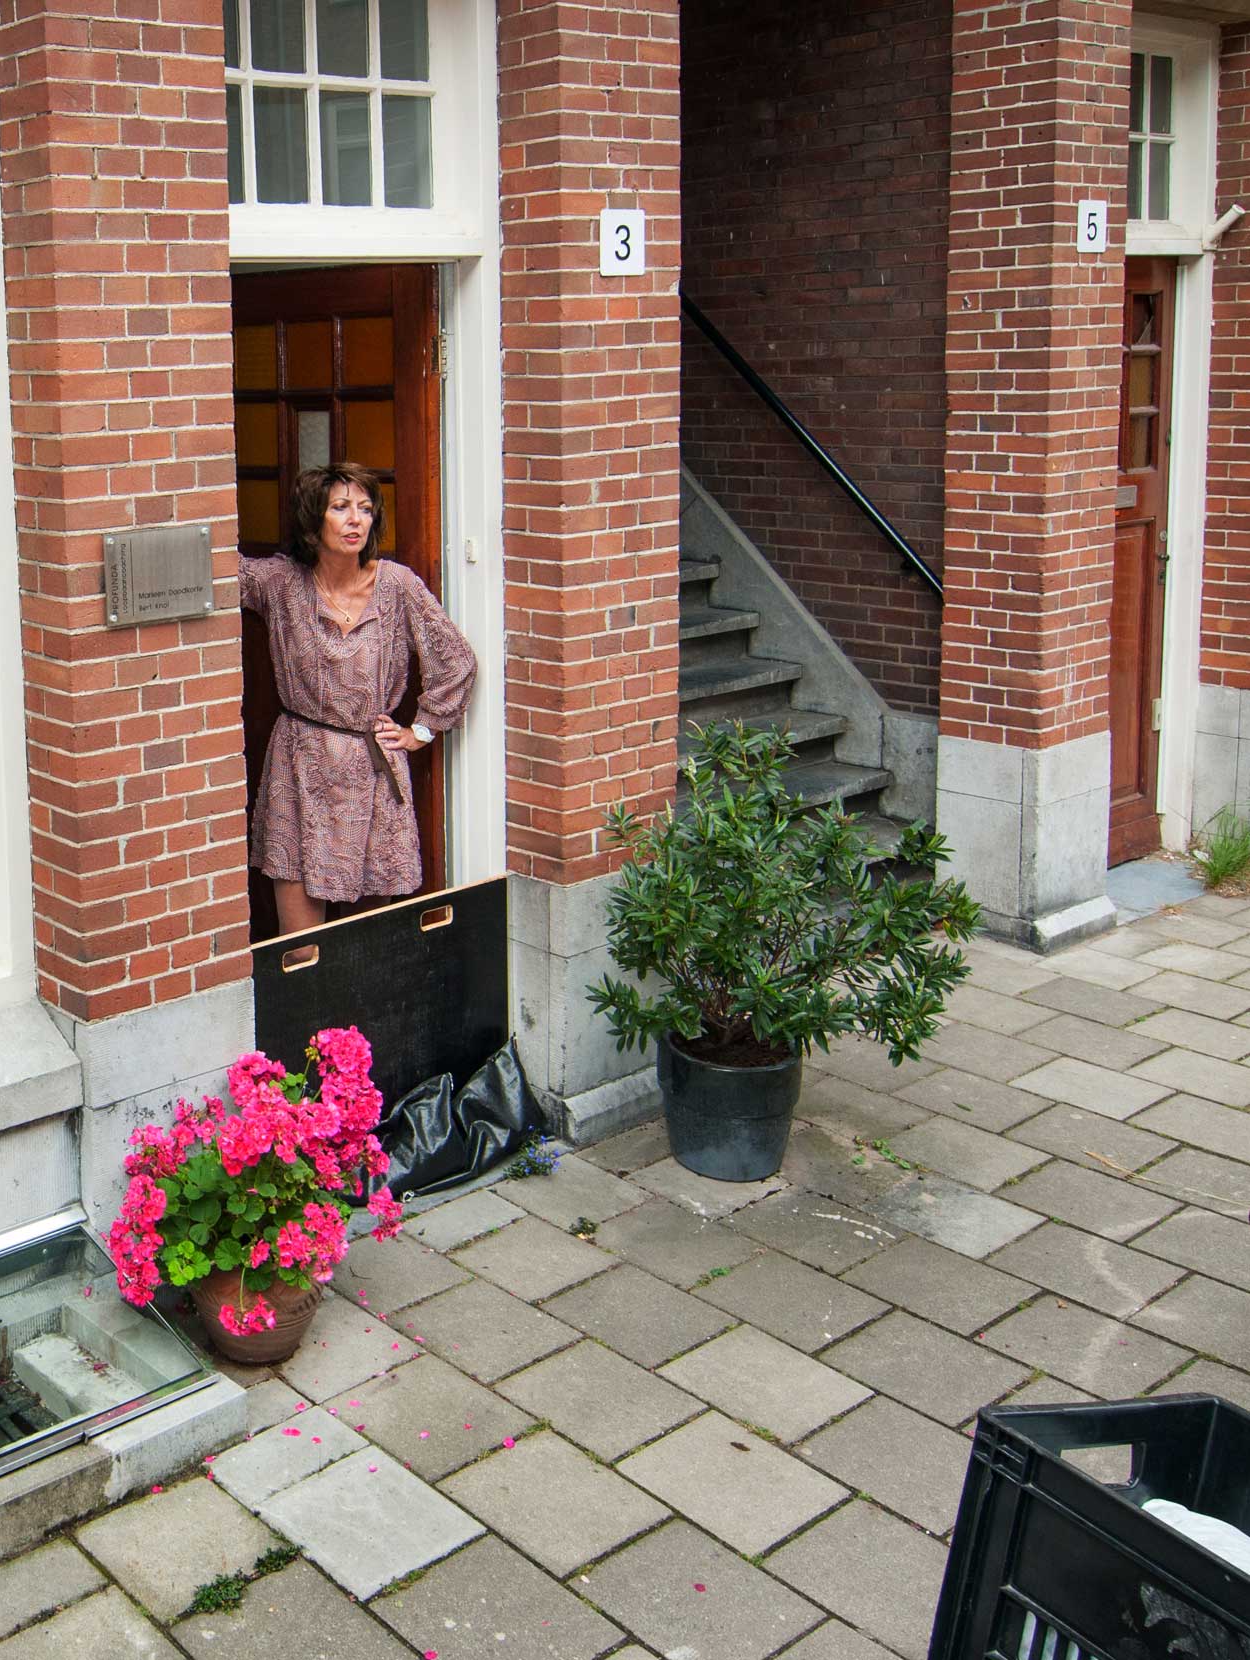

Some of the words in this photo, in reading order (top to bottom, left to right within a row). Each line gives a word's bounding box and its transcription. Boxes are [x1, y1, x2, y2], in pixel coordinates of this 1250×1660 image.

[614, 224, 631, 261] 3
[1087, 212, 1097, 241] 5
[111, 564, 119, 614] PROFUNDA
